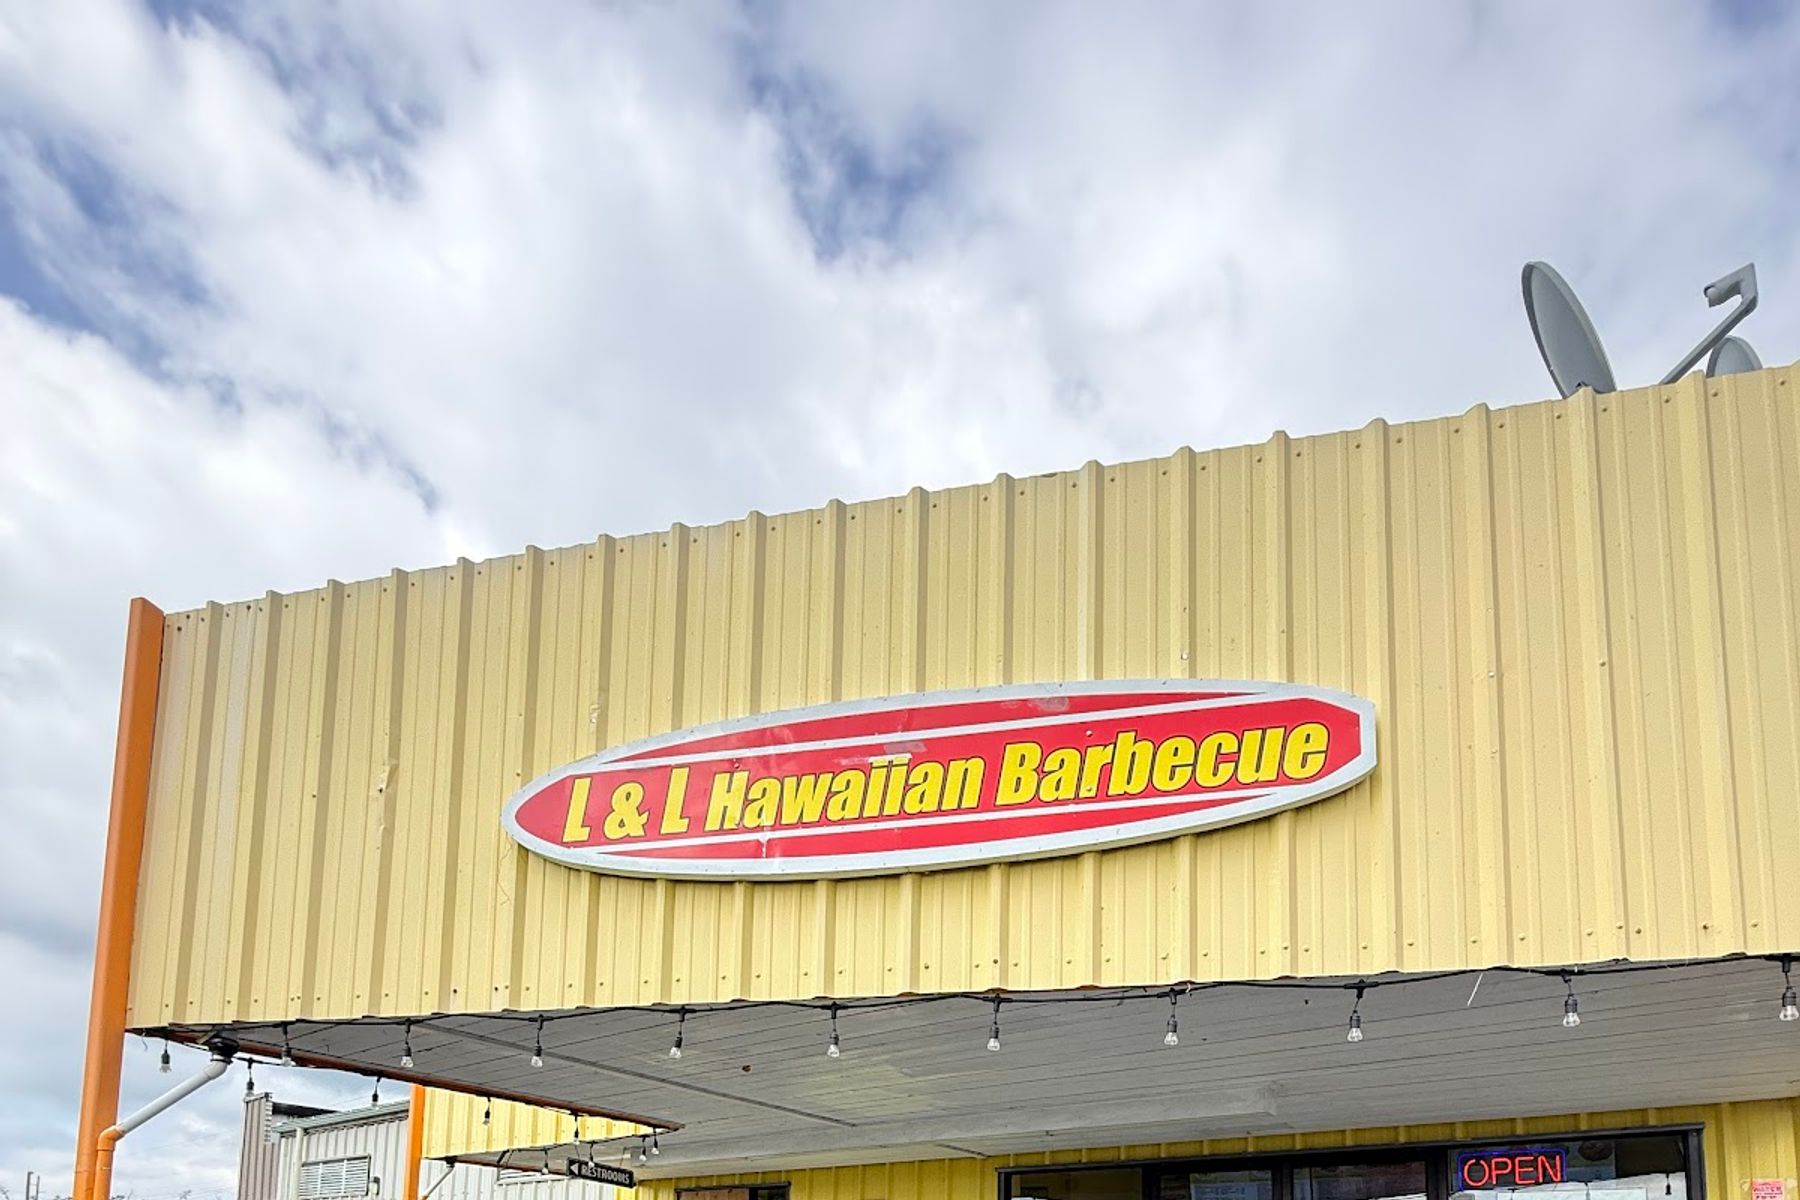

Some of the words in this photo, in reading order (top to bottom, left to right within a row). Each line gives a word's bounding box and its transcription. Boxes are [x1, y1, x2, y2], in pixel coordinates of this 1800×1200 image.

[561, 776, 593, 843] L
[602, 780, 649, 840] &
[659, 765, 691, 836] L
[702, 755, 986, 832] Hawaiian
[994, 721, 1330, 807] Barbecue
[580, 1163, 630, 1185] RESTROOMS
[1463, 1154, 1562, 1187] OPEN
